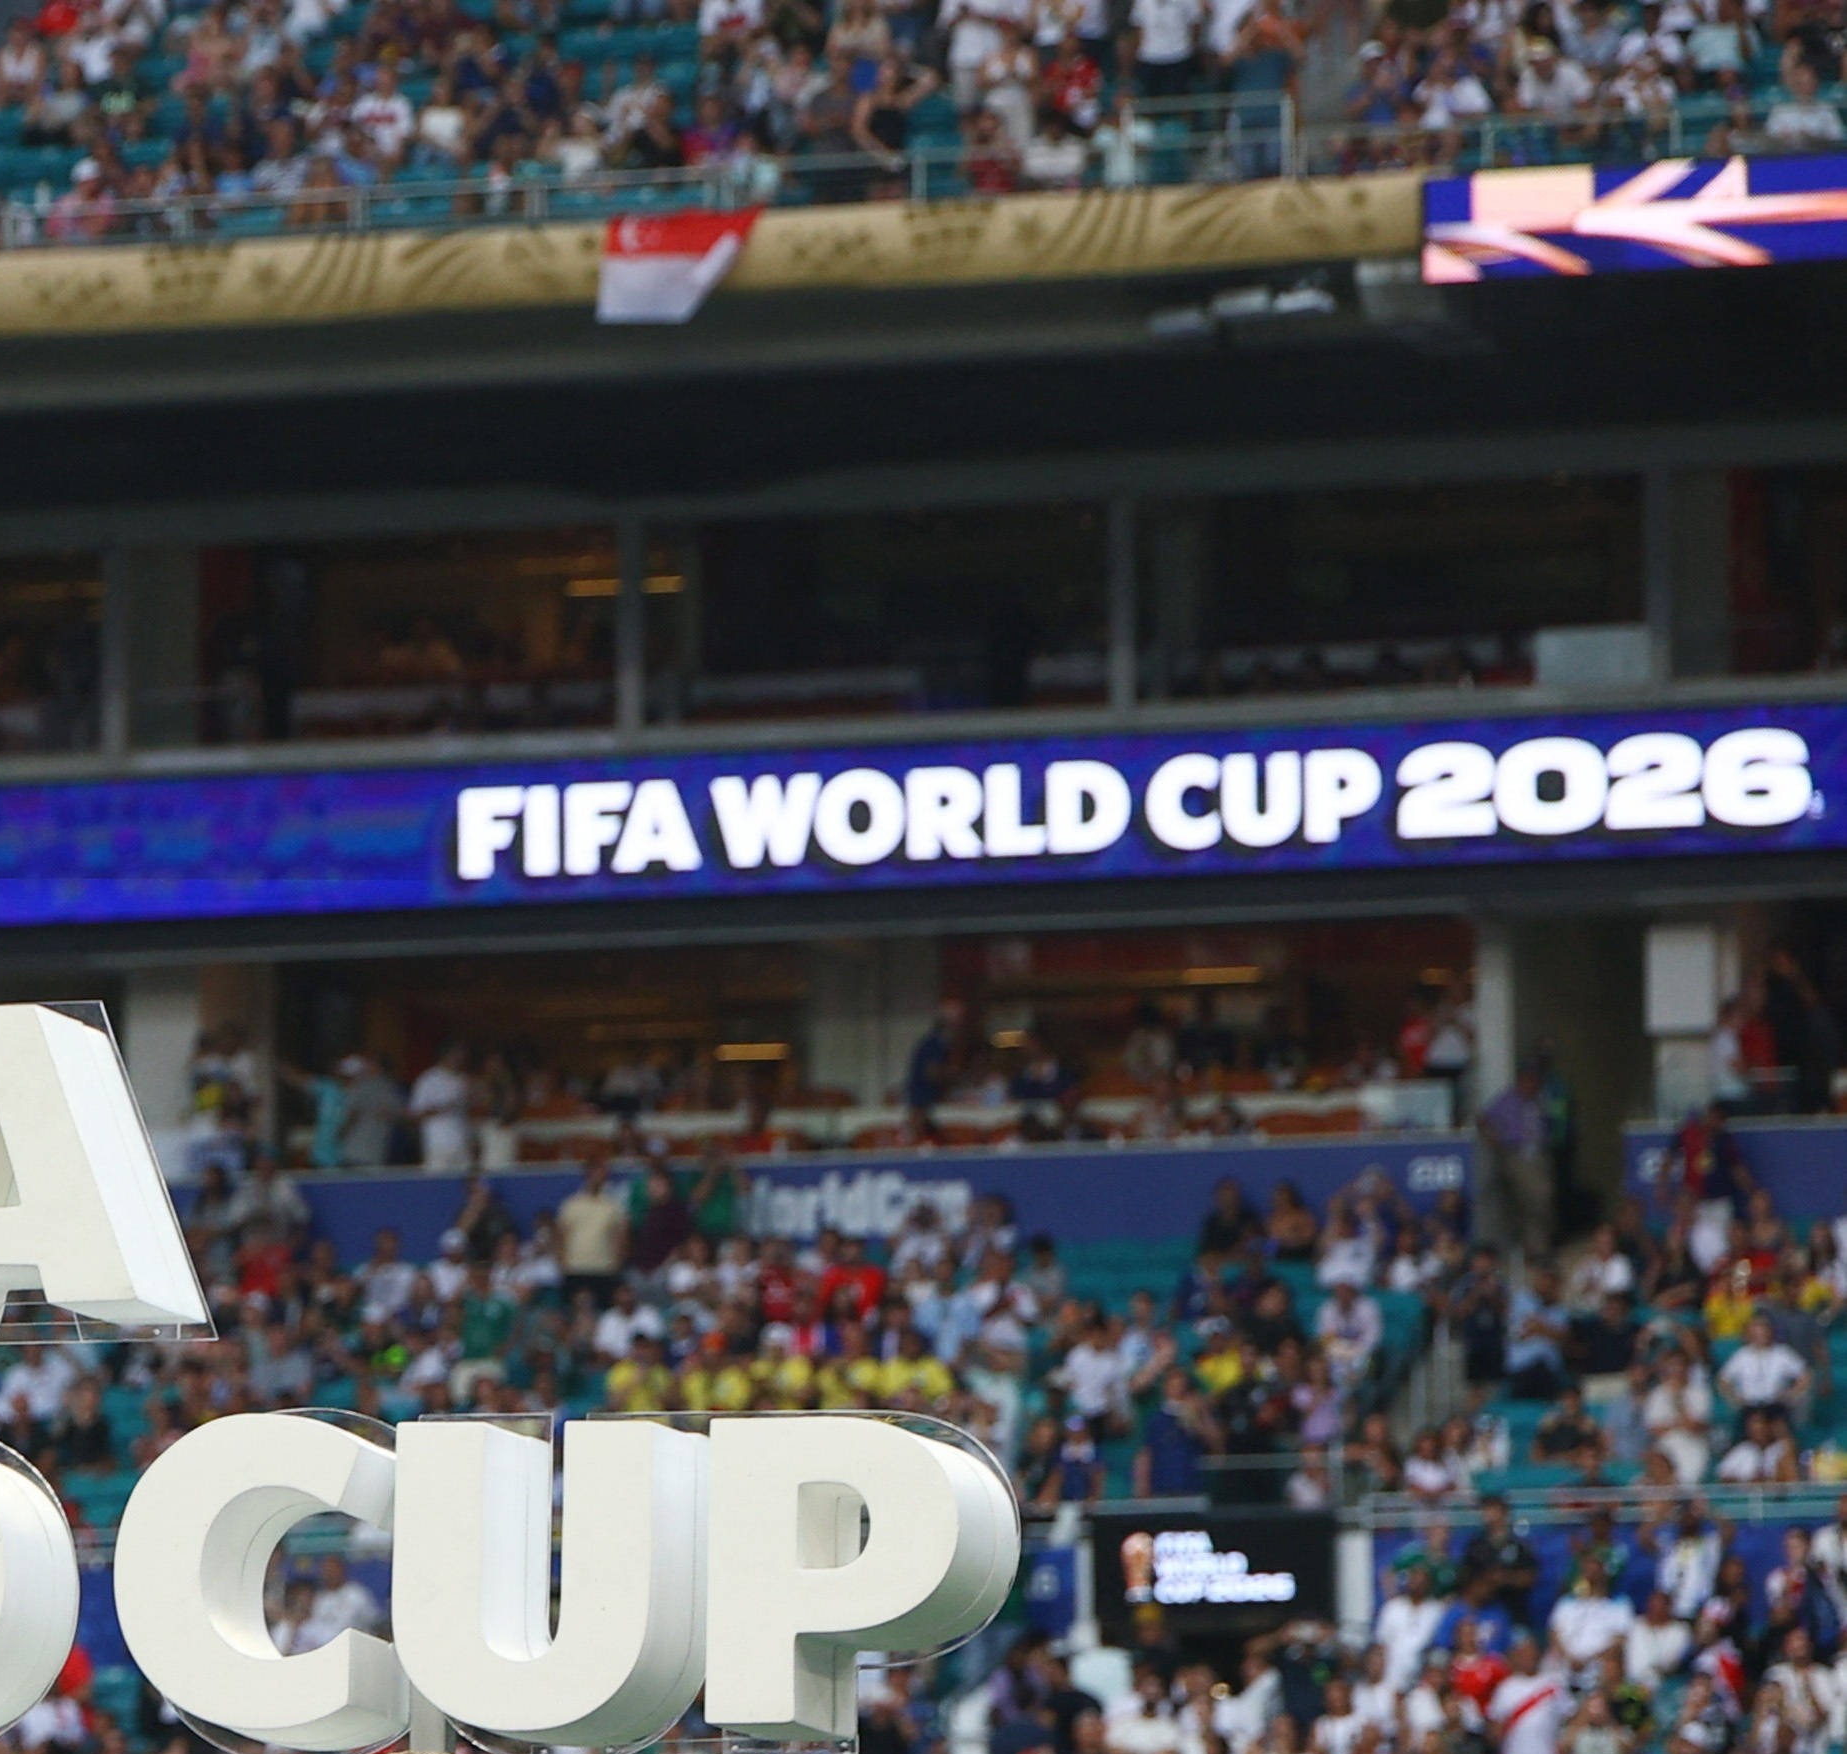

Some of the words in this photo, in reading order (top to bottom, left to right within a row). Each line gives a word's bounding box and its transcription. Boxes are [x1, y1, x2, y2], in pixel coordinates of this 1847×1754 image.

[457, 778, 702, 880] FIFA
[711, 760, 1133, 869] WORLD
[1145, 748, 1382, 851] CUP
[1396, 727, 1813, 841] 2026
